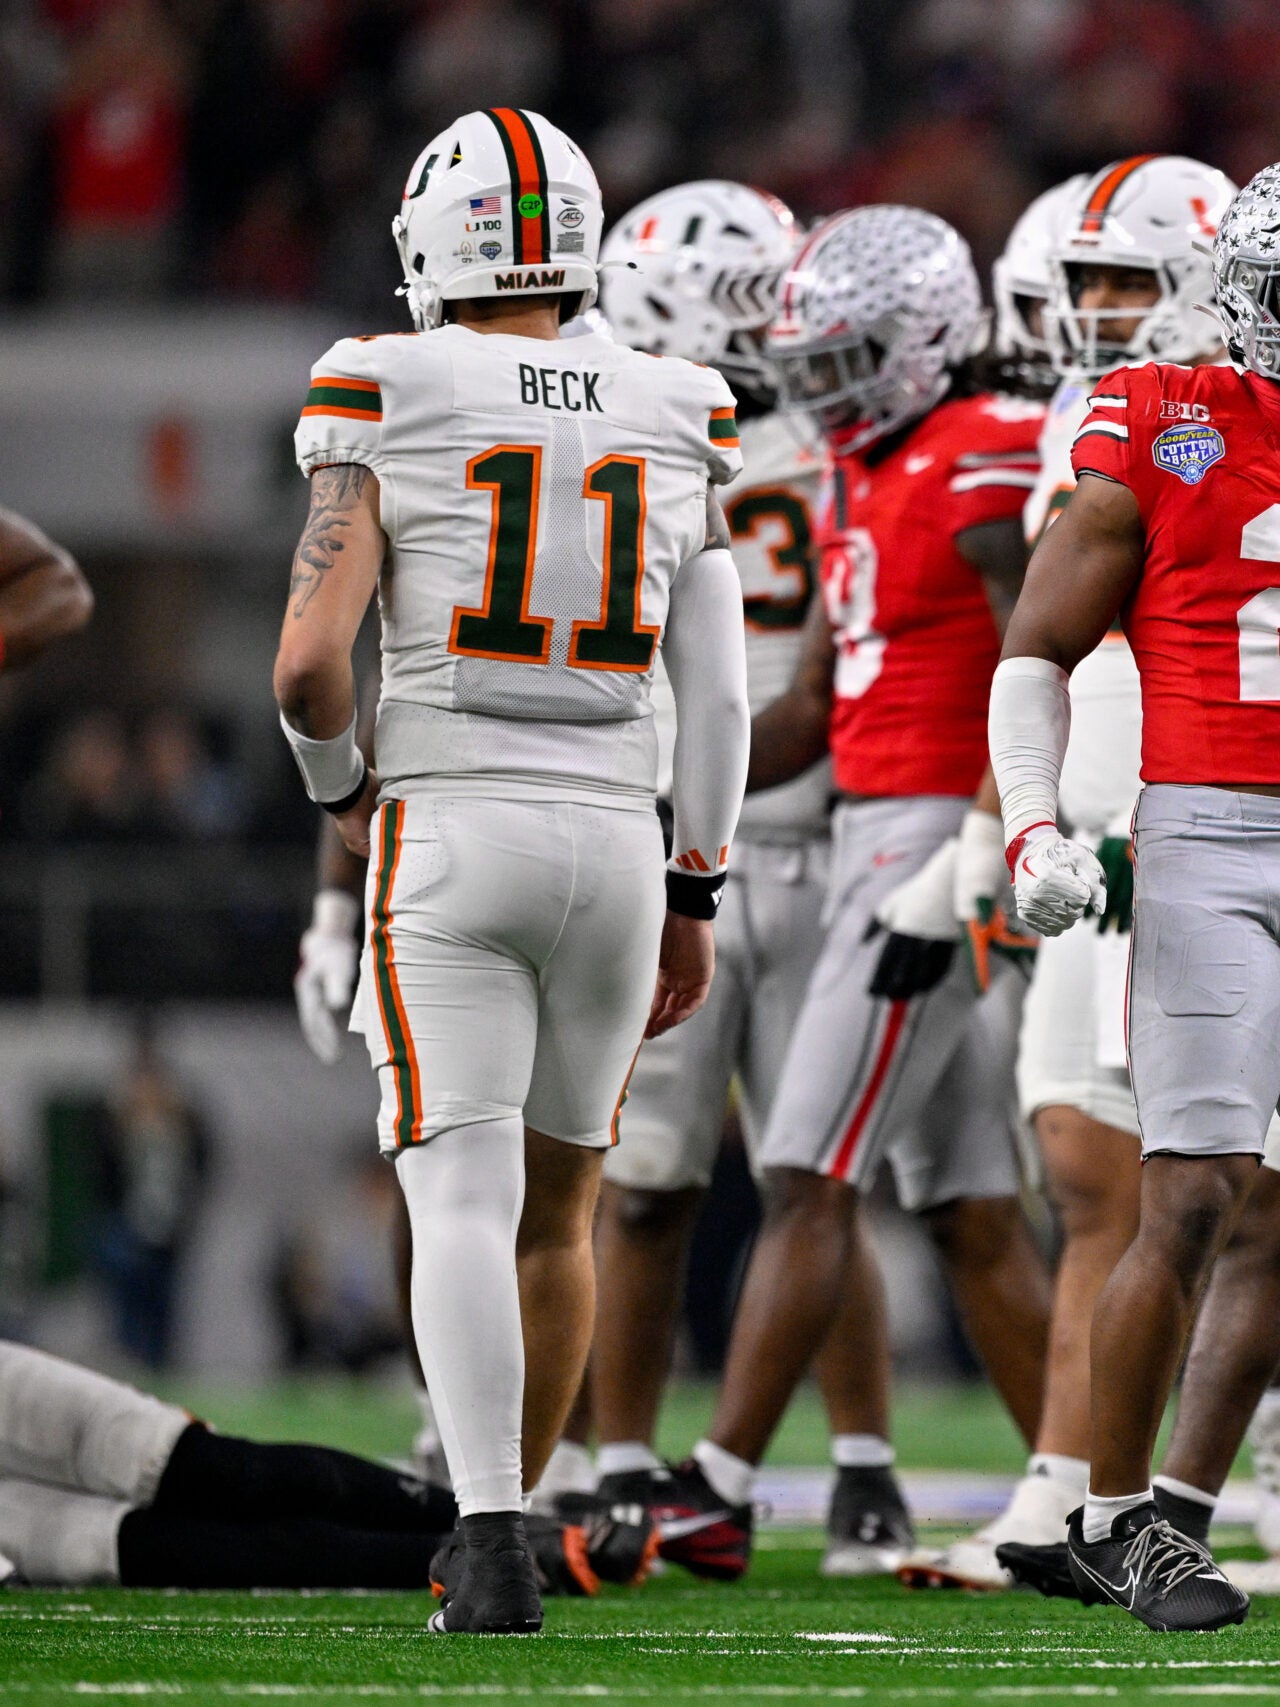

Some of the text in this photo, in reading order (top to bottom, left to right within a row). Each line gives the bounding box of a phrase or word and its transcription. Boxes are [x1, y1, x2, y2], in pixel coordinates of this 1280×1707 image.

[520, 200, 541, 211] C2P
[483, 219, 502, 231] 100
[494, 270, 566, 291] MIAMI
[518, 362, 605, 413] BECK
[1159, 430, 1215, 444] GOODYEAR
[1159, 438, 1219, 463] COTTON
[1171, 449, 1209, 465] BOWL
[447, 443, 662, 674] 11
